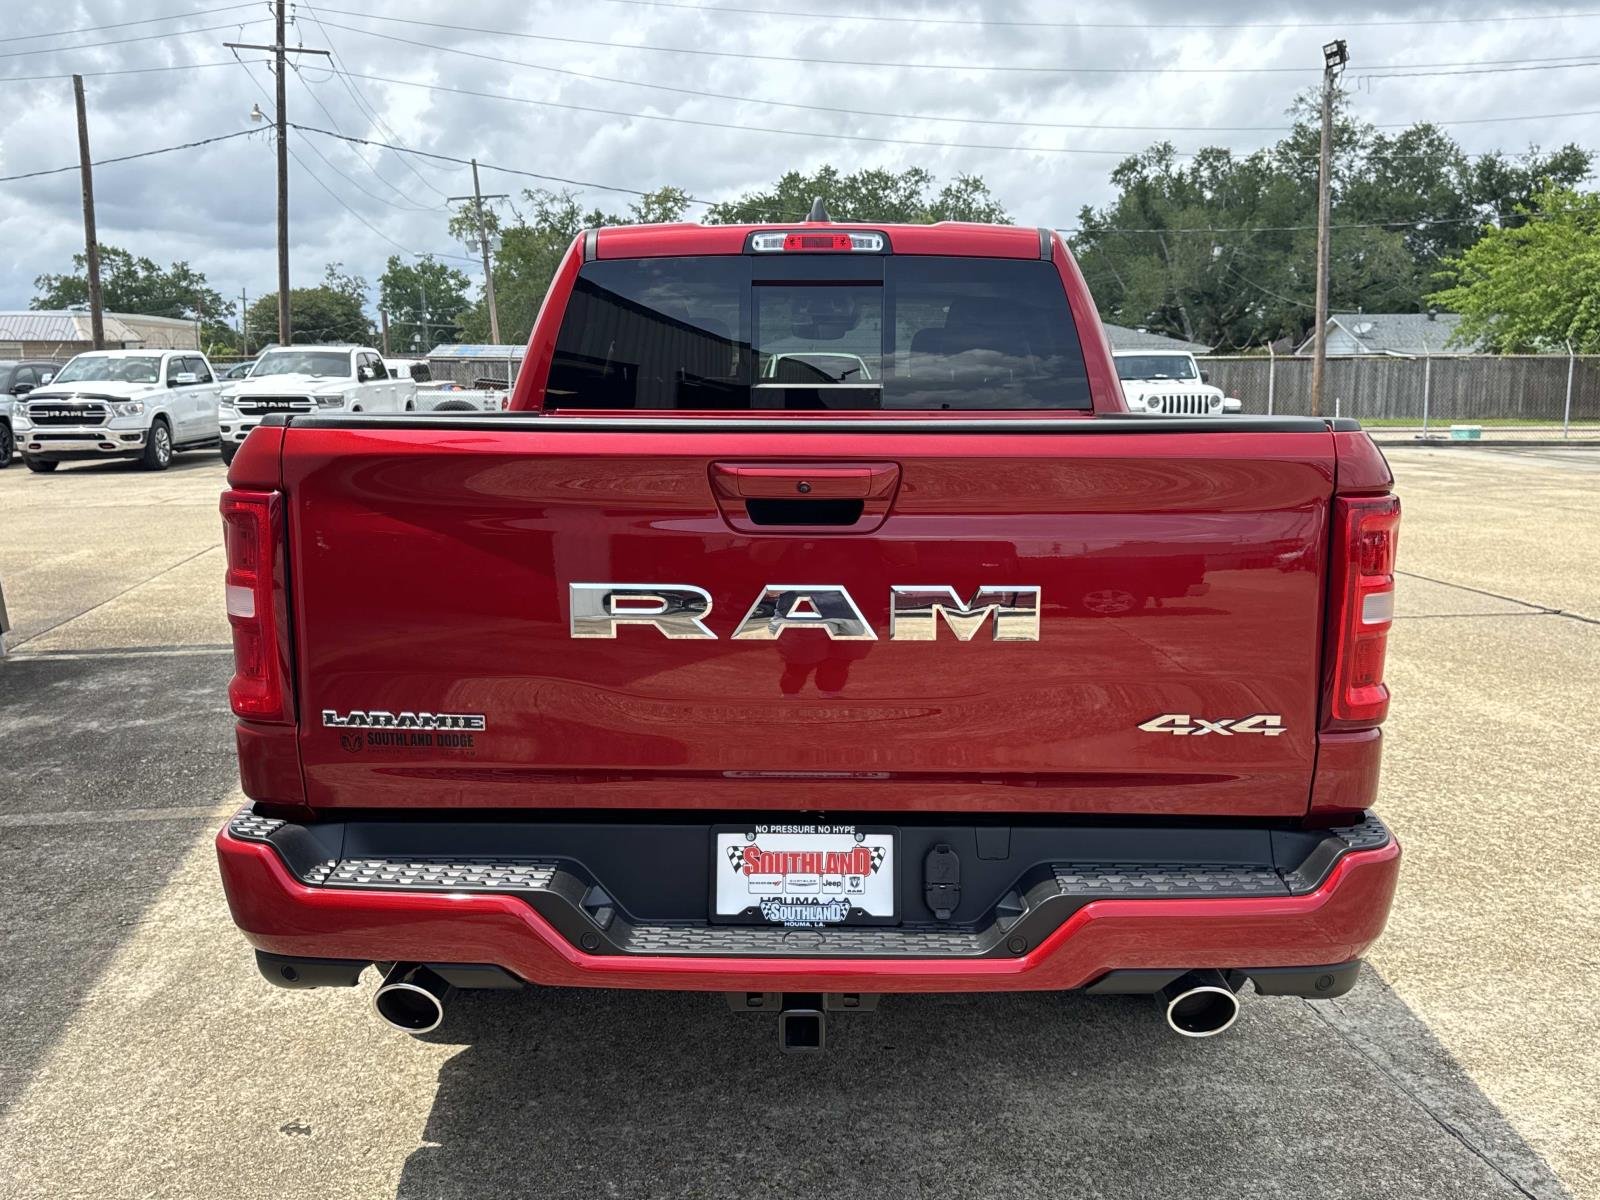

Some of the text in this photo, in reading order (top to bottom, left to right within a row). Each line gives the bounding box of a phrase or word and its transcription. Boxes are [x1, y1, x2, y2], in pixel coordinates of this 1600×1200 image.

[569, 583, 1041, 642] RAM
[322, 709, 486, 732] LARAMIE
[1137, 713, 1288, 737] 4x4
[367, 731, 475, 748] SOUTHLAND DODGE
[755, 825, 856, 834] NO PRESSURE NO HYPE
[743, 846, 872, 877] SOUTHLAND
[822, 879, 842, 888] Jeep
[770, 903, 841, 921] SOUTHLAND
